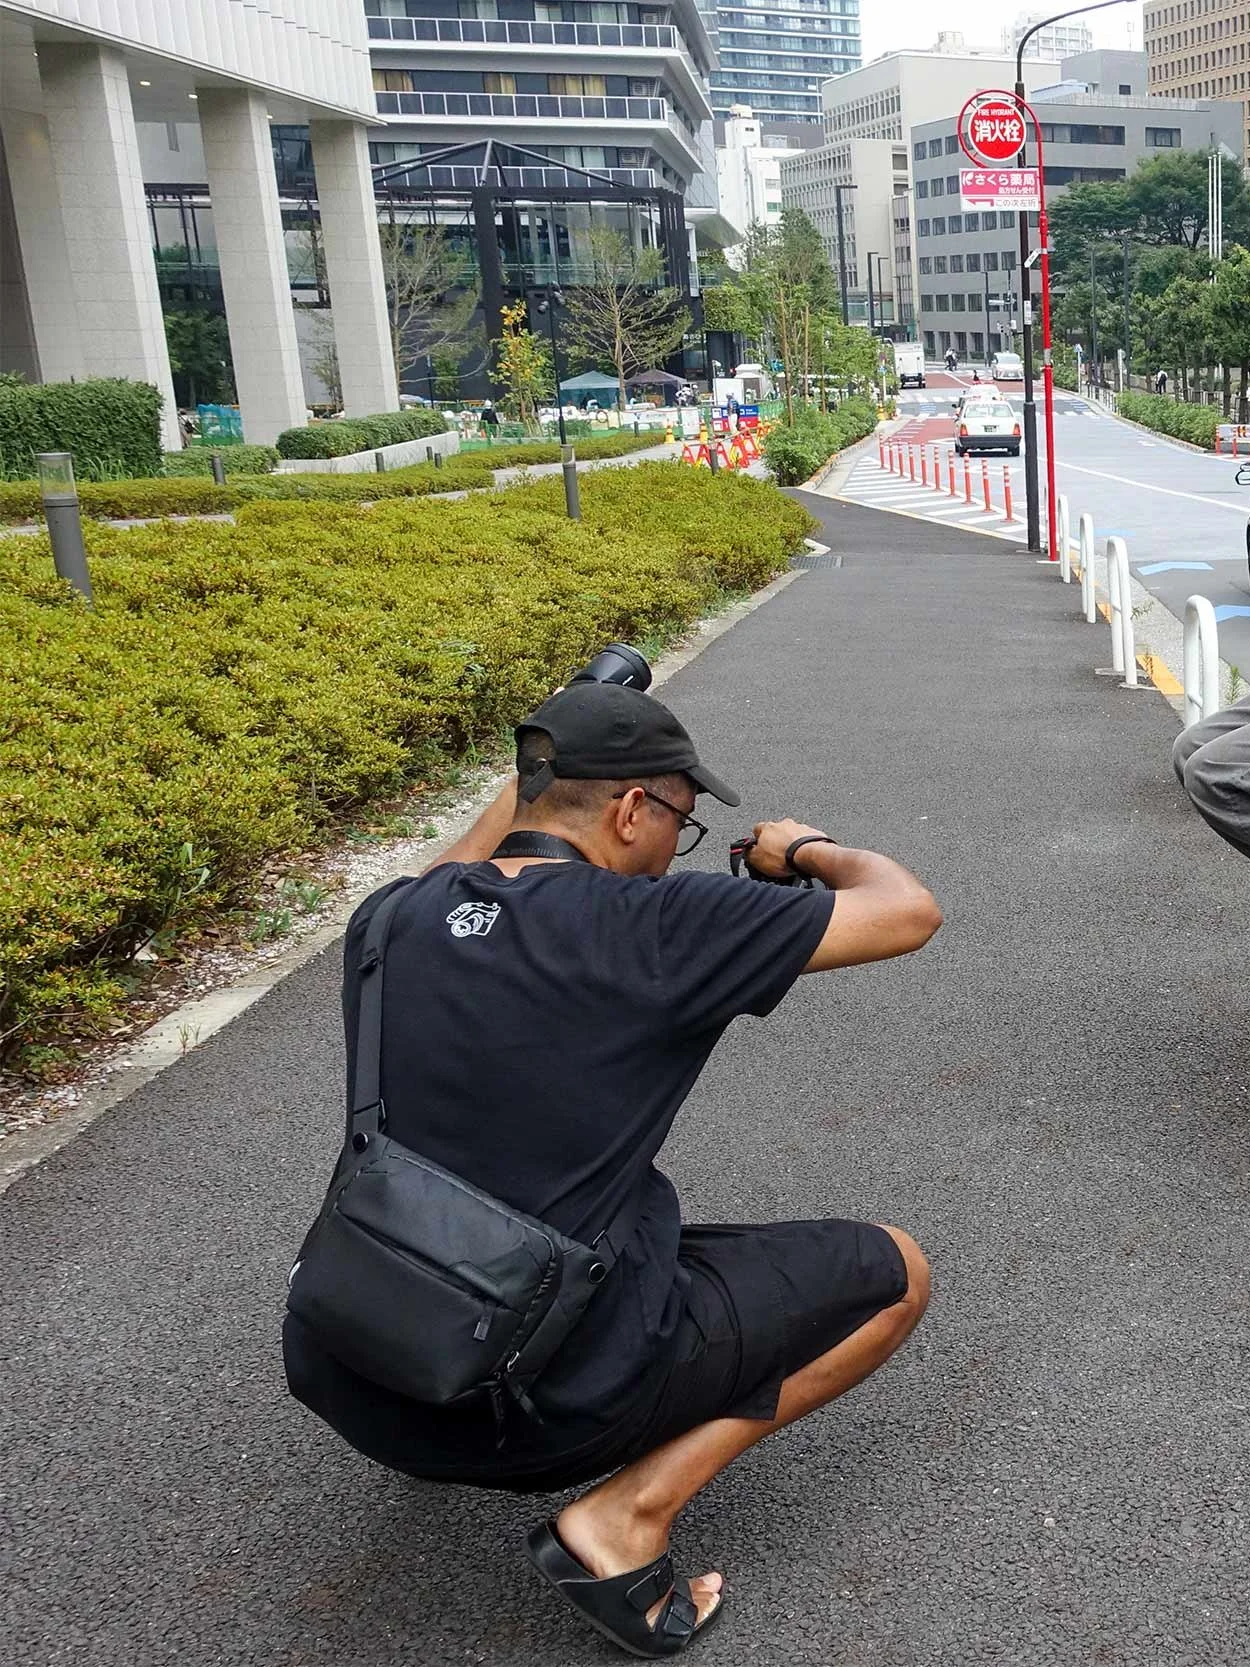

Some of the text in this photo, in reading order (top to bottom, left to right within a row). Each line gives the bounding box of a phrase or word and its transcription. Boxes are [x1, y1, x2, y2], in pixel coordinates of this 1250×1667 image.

[974, 118, 1021, 143] 消火栓
[974, 173, 1035, 186] さくら薬局
